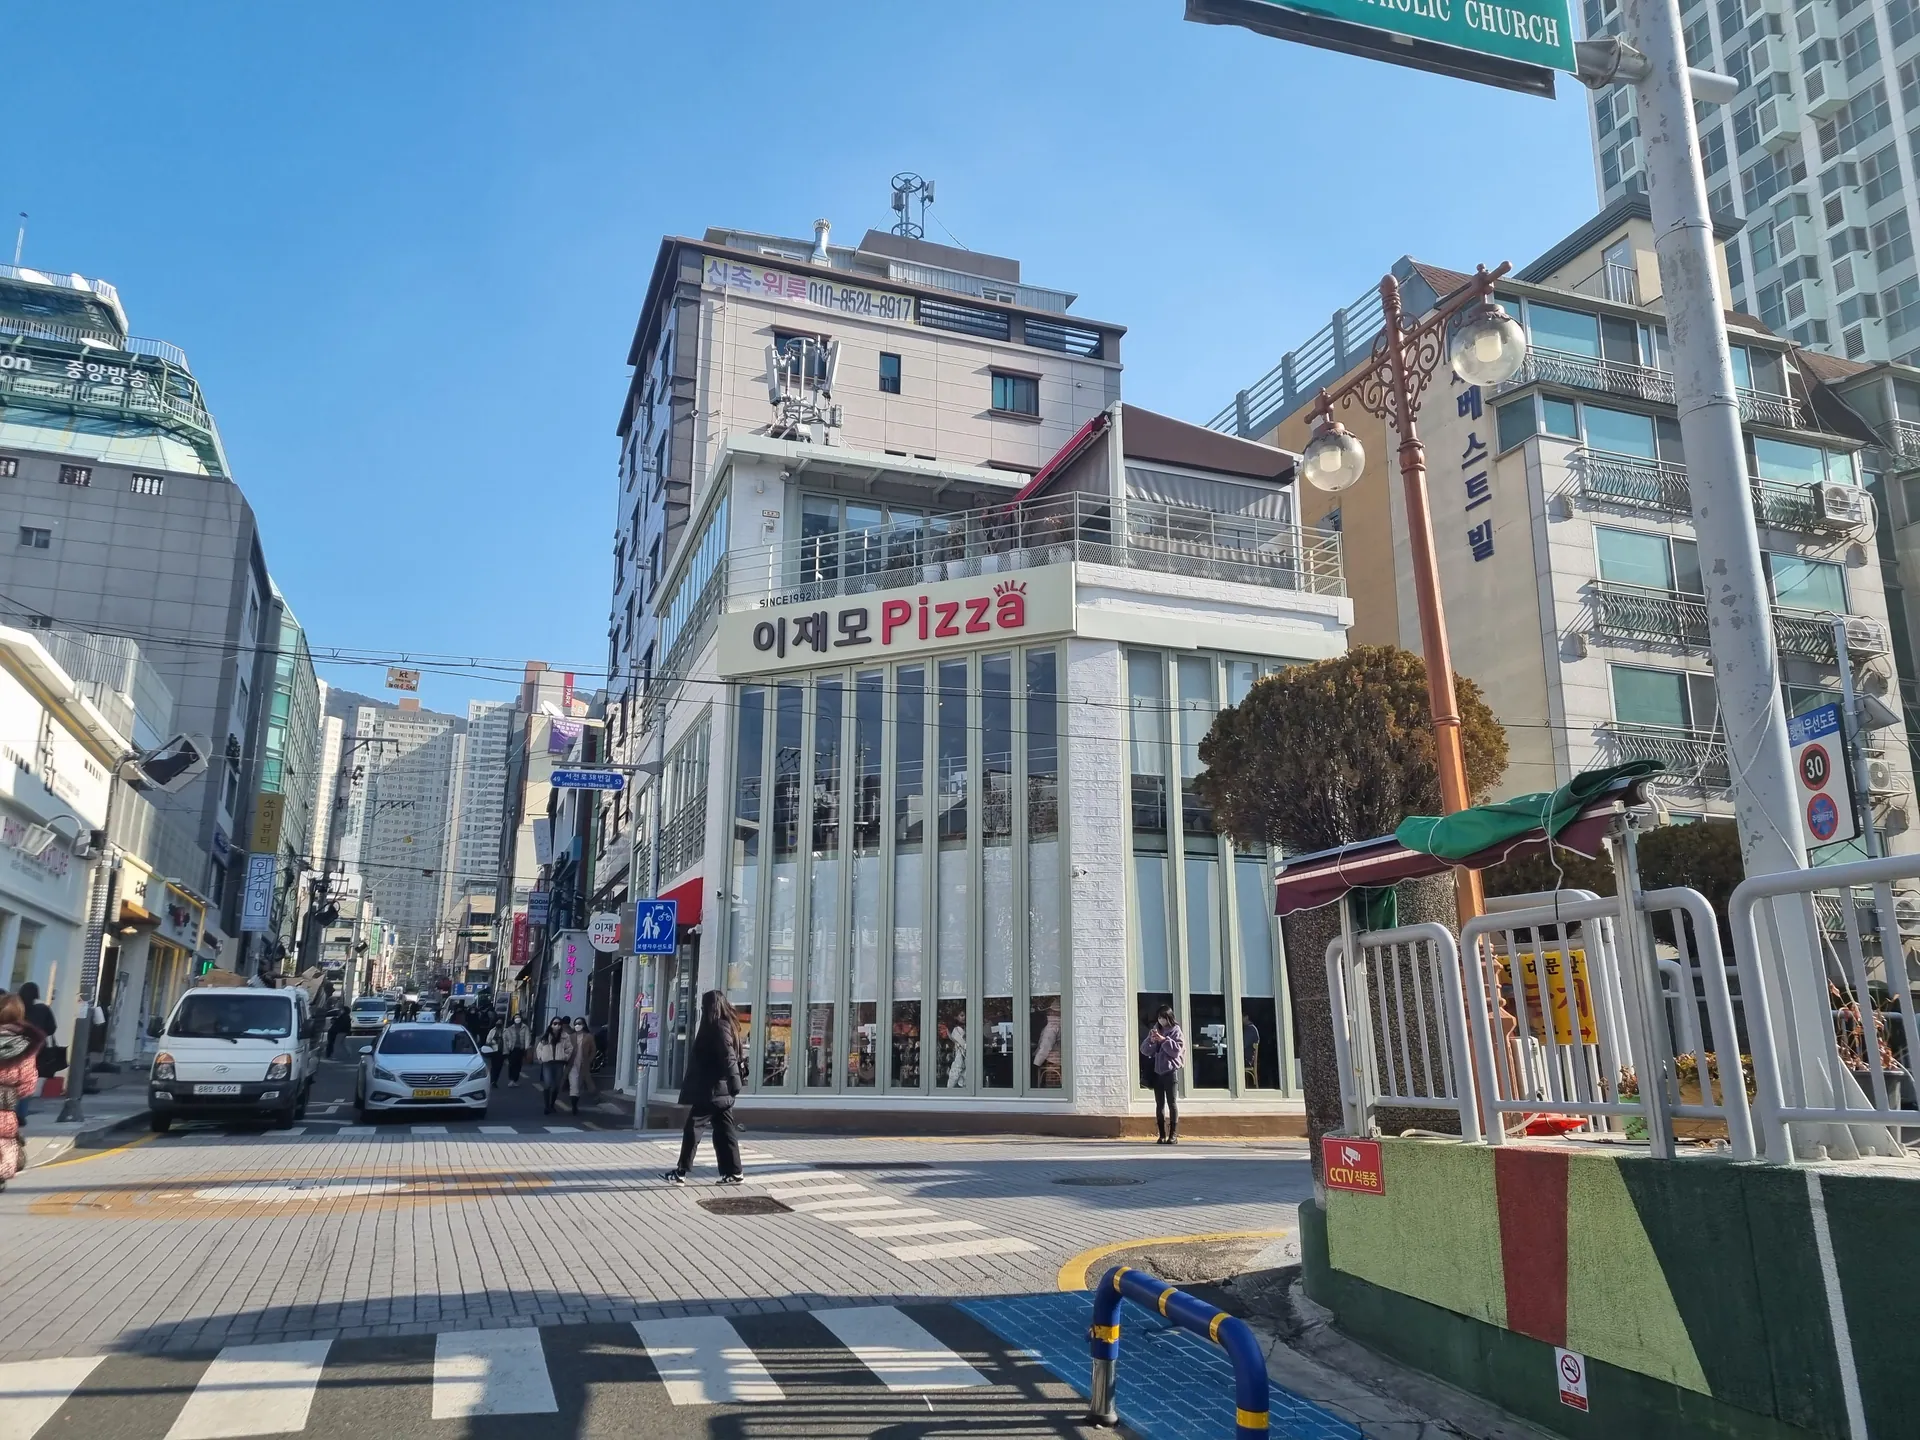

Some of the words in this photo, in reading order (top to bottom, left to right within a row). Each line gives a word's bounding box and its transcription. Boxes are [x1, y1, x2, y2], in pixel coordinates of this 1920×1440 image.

[1464, 0, 1560, 47] CHURCH
[808, 280, 913, 322] 010-8524-8917
[65, 359, 148, 389] 중앙방송
[993, 579, 1028, 596] HILL
[752, 608, 872, 659] 이재모
[881, 593, 1025, 645] Pizza
[1806, 755, 1824, 779] 30
[593, 934, 619, 944] Pizz
[1329, 1167, 1354, 1184] CCTV
[1354, 1170, 1378, 1187] 작동중
